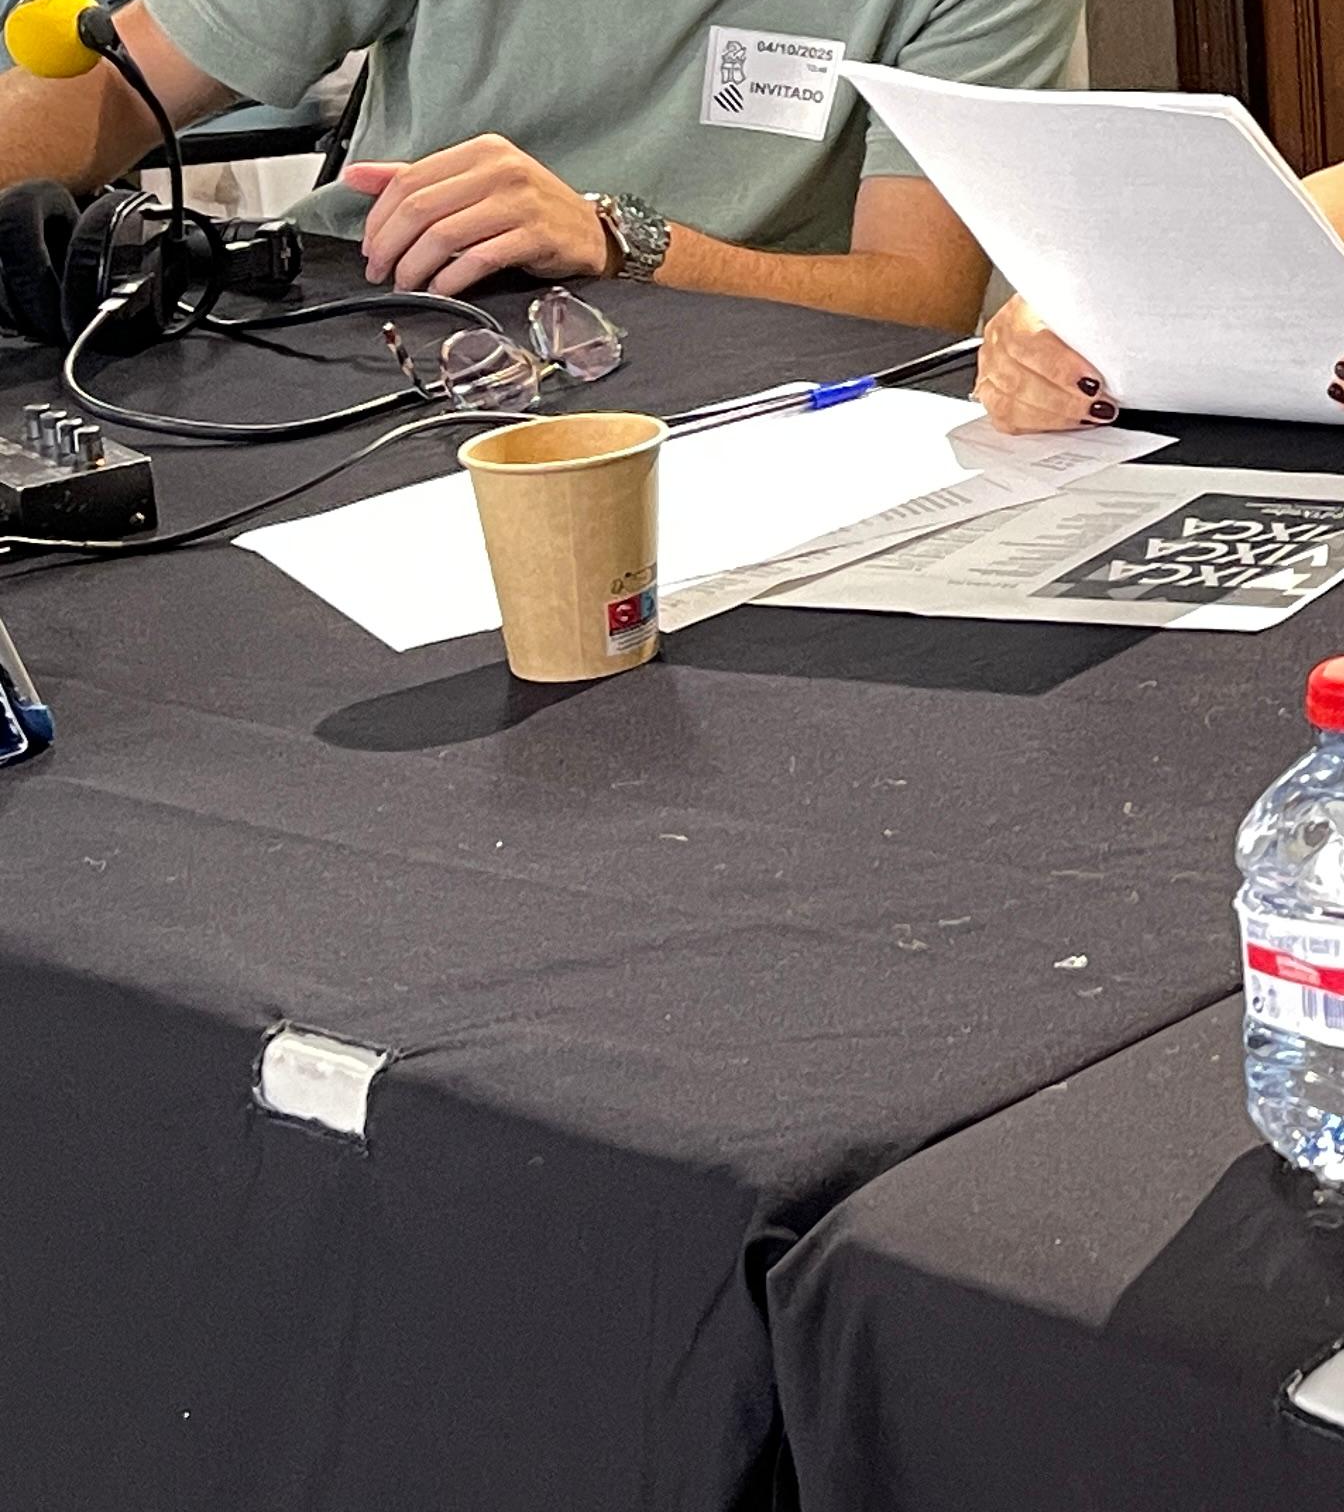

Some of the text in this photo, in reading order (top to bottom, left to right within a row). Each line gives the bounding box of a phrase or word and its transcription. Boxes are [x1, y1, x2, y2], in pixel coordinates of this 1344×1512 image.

[757, 40, 833, 61] 04/10/2025
[750, 81, 824, 103] INVITADO
[1145, 538, 1329, 567] VIXCA
